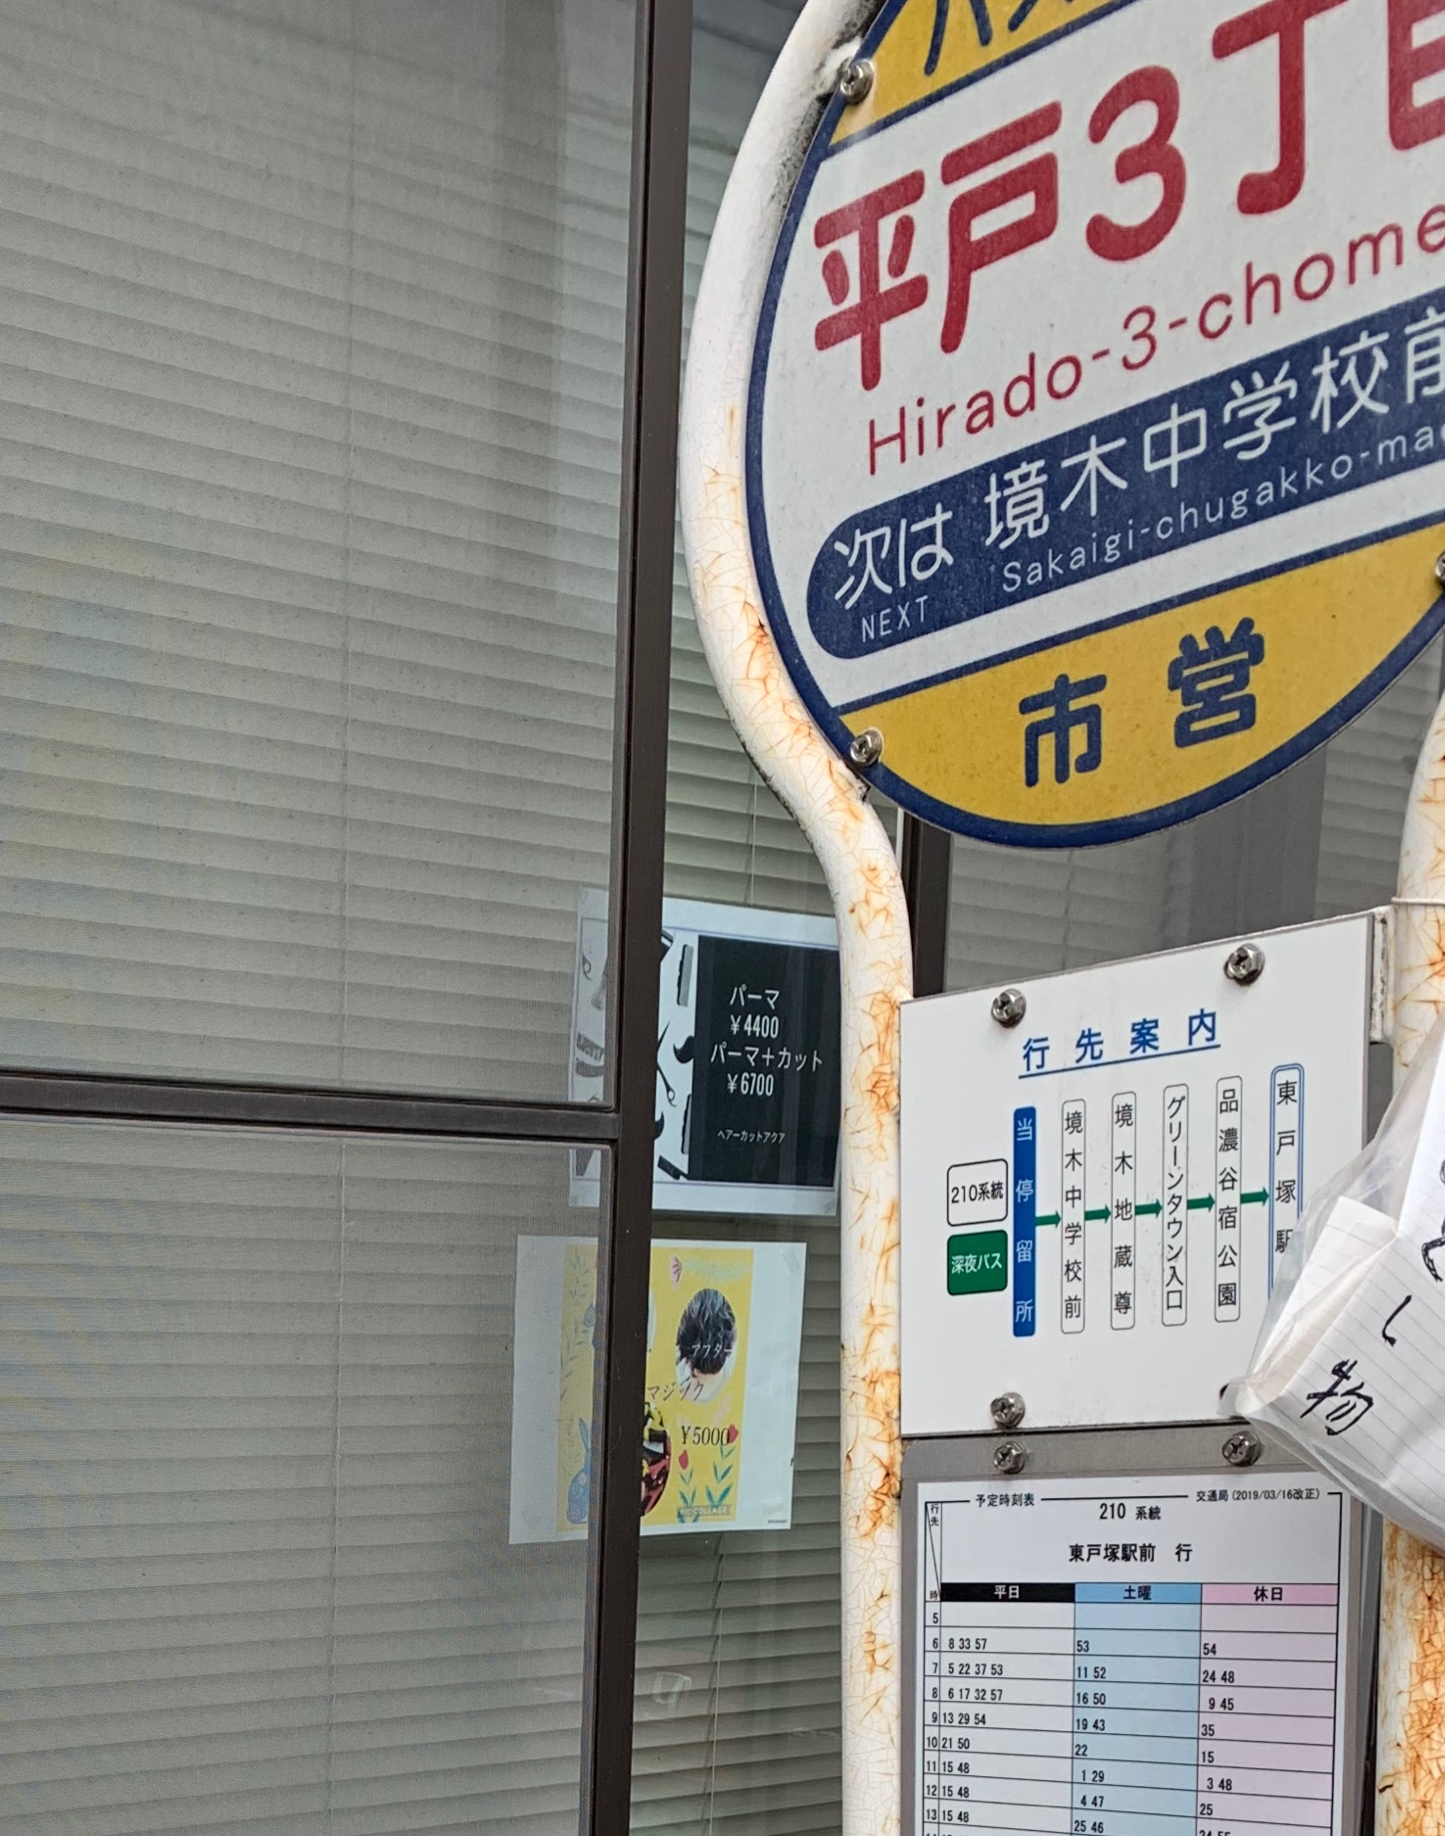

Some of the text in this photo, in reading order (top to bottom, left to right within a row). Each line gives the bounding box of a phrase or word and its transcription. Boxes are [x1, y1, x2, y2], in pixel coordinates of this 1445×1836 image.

[867, 204, 1445, 476] Hirado-3-chome
[1002, 420, 1445, 593] Sakaigi-chugakko-ma
[834, 503, 955, 610] 次は
[861, 596, 928, 642] NEXT
[1017, 616, 1265, 788] 市営
[729, 984, 781, 1010] パーマ
[729, 1014, 780, 1038] ¥4400
[1021, 1007, 1218, 1072] 行先案内
[727, 1073, 775, 1096] ¥6700
[717, 1129, 786, 1144] ヘアーカットアクア
[951, 1180, 1004, 1204] 210系統
[1165, 1094, 1187, 1311] グリーンタウン入口
[1217, 1088, 1239, 1308] 品濃谷宿公園
[1014, 1117, 1034, 1323] 当停留所
[1064, 1110, 1083, 1320] 境木中学校前
[1113, 1104, 1133, 1315] 境木地蔵尊
[951, 1252, 1003, 1276] 深夜バス
[681, 1425, 731, 1446] ¥5000
[975, 1493, 1035, 1508] 予定時刻表
[1196, 1488, 1320, 1502] 交通局 (2019/03/16改正)
[1099, 1502, 1162, 1521] 210 系統
[1069, 1543, 1193, 1563] 東戸塚駅前 行
[994, 1585, 1020, 1599] 平日
[1123, 1585, 1152, 1600] 土曜
[1253, 1586, 1283, 1602] 休日
[932, 1638, 987, 1650] 6 8 33 57
[1076, 1640, 1089, 1652] 53
[1203, 1643, 1217, 1655] 54
[933, 1663, 1003, 1675] 7 5 22 37 53
[1077, 1666, 1106, 1679] 11 52
[1203, 1670, 1235, 1683] 24 48
